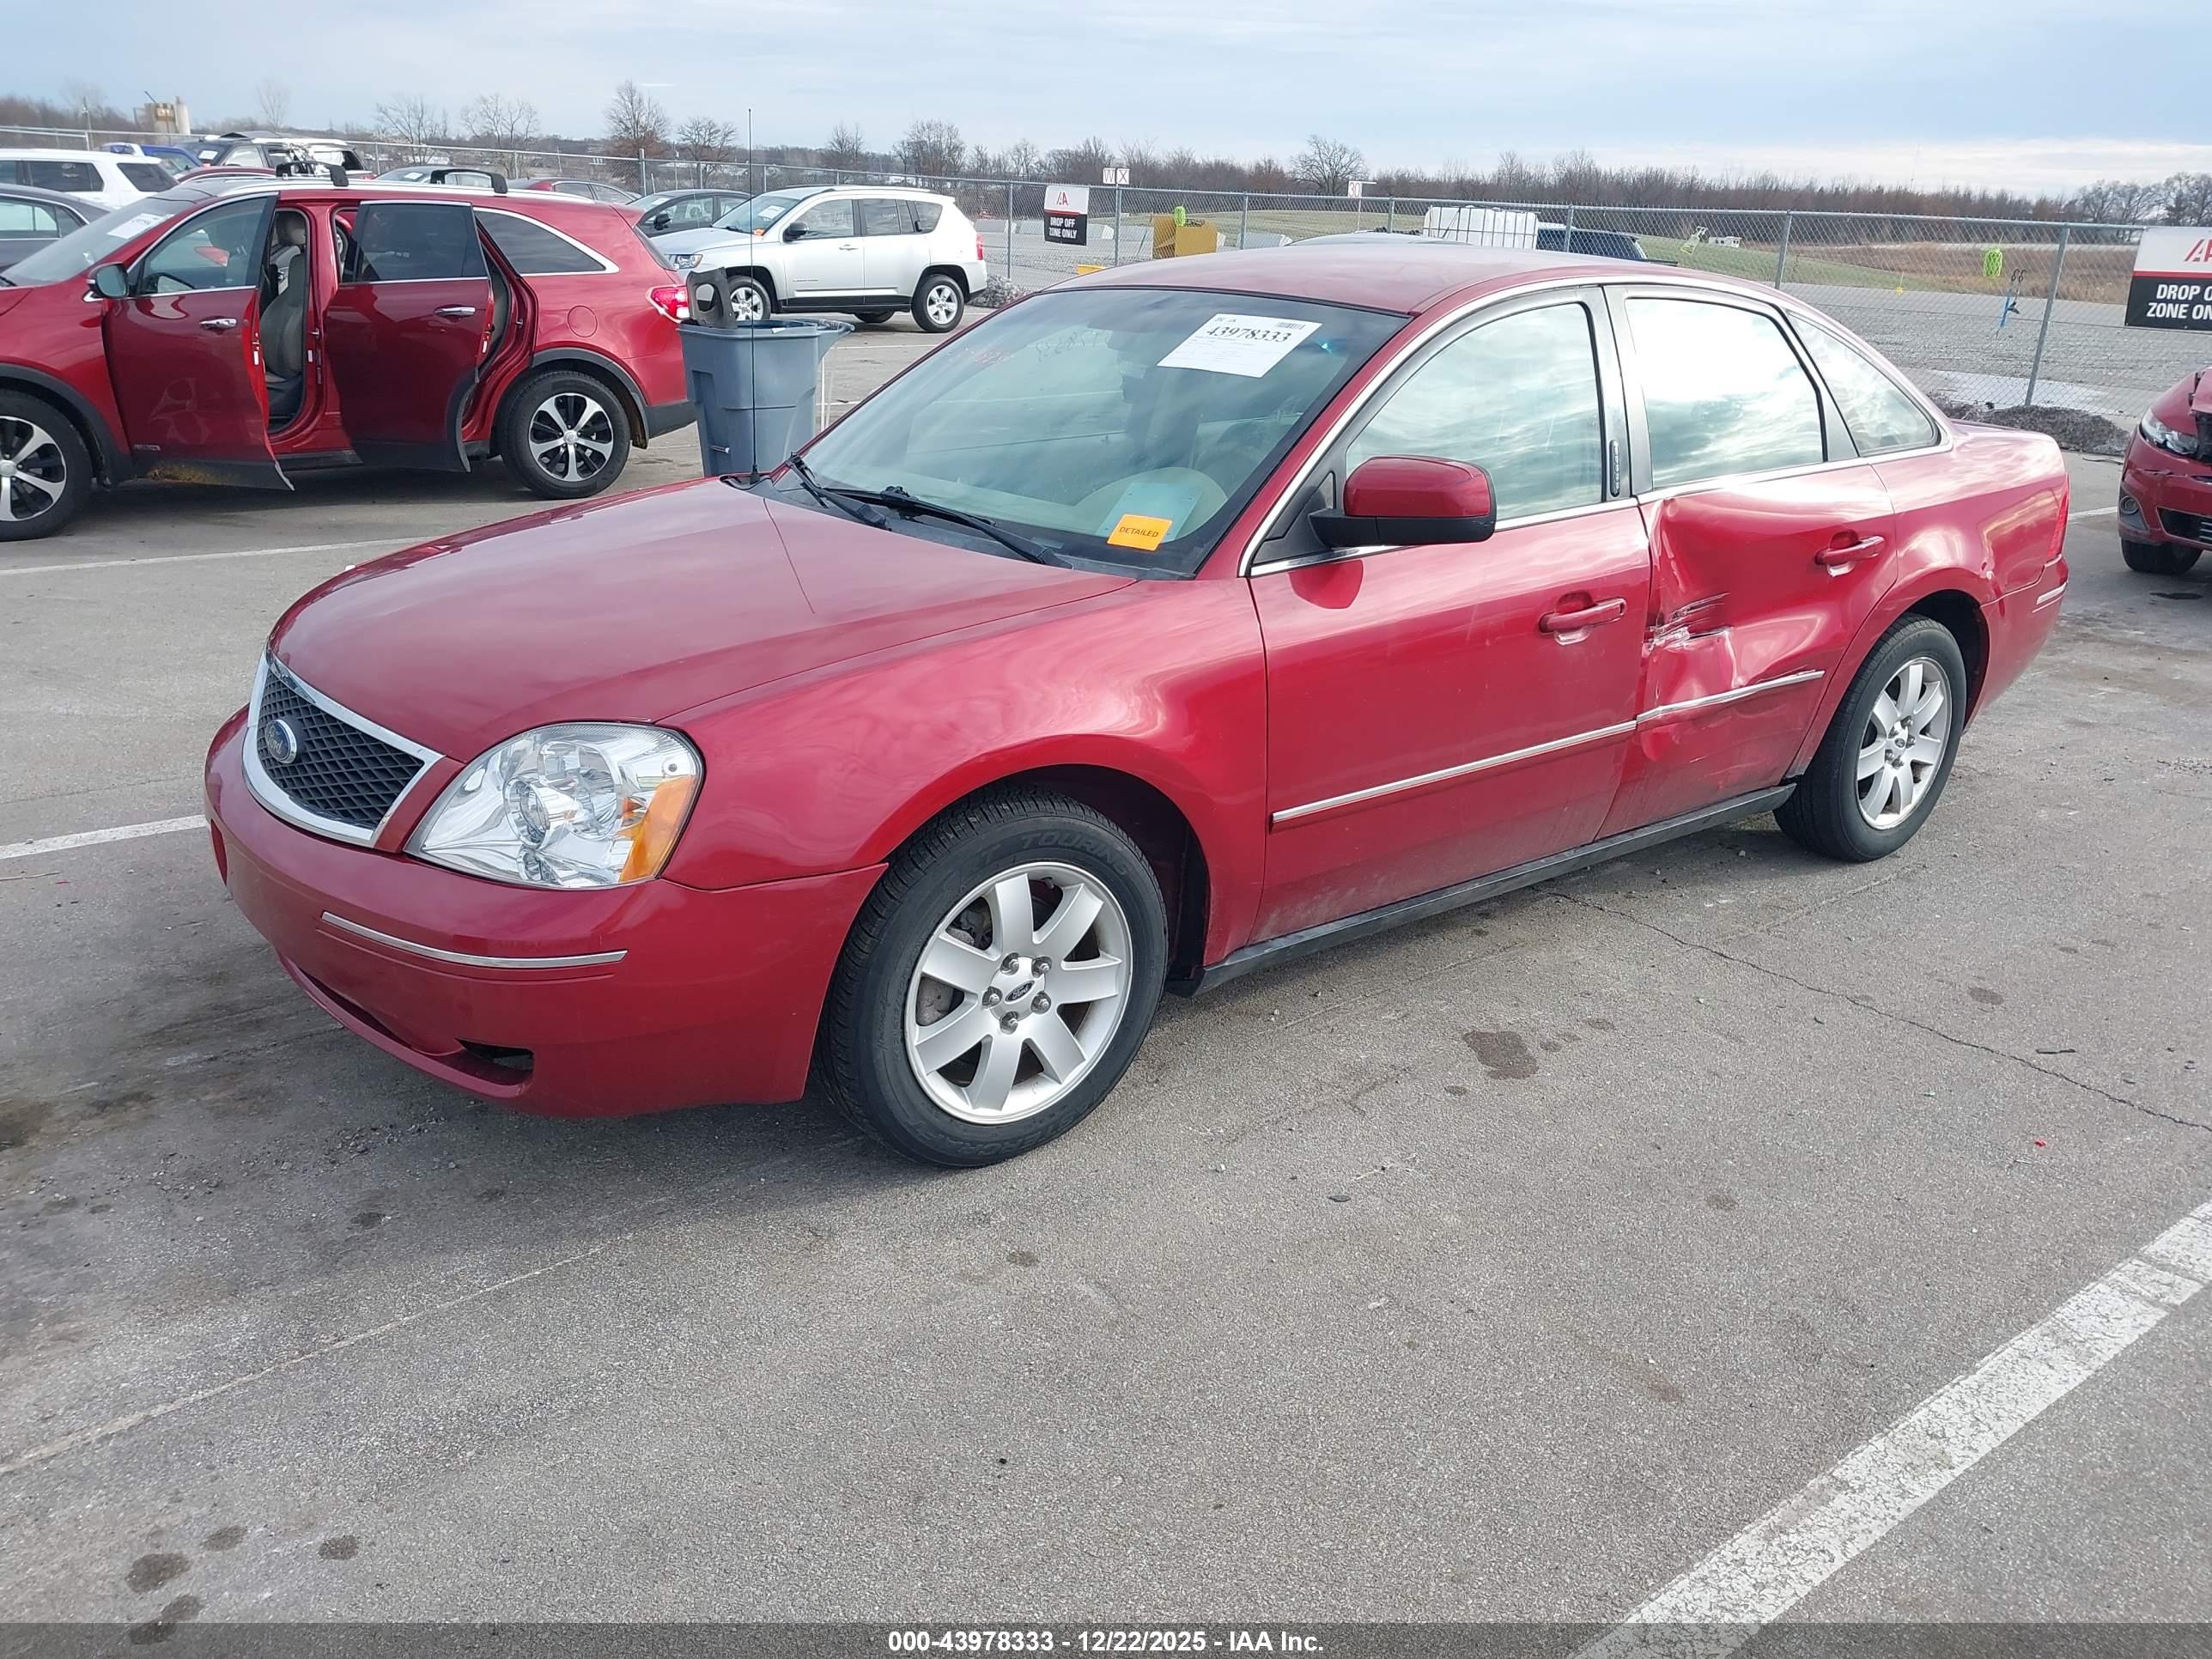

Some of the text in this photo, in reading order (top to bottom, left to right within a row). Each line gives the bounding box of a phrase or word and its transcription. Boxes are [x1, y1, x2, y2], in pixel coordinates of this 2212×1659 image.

[1103, 169, 1114, 183] W
[1118, 169, 1127, 183] X
[1349, 181, 1360, 198] 30
[1050, 216, 1076, 228] DROP OFF
[1048, 227, 1078, 239] ZONE ONLY
[2156, 283, 2201, 301] DROP
[2147, 302, 2190, 319] ZONE
[1206, 325, 1292, 343] 43978333
[1119, 526, 1159, 538] DETAILED
